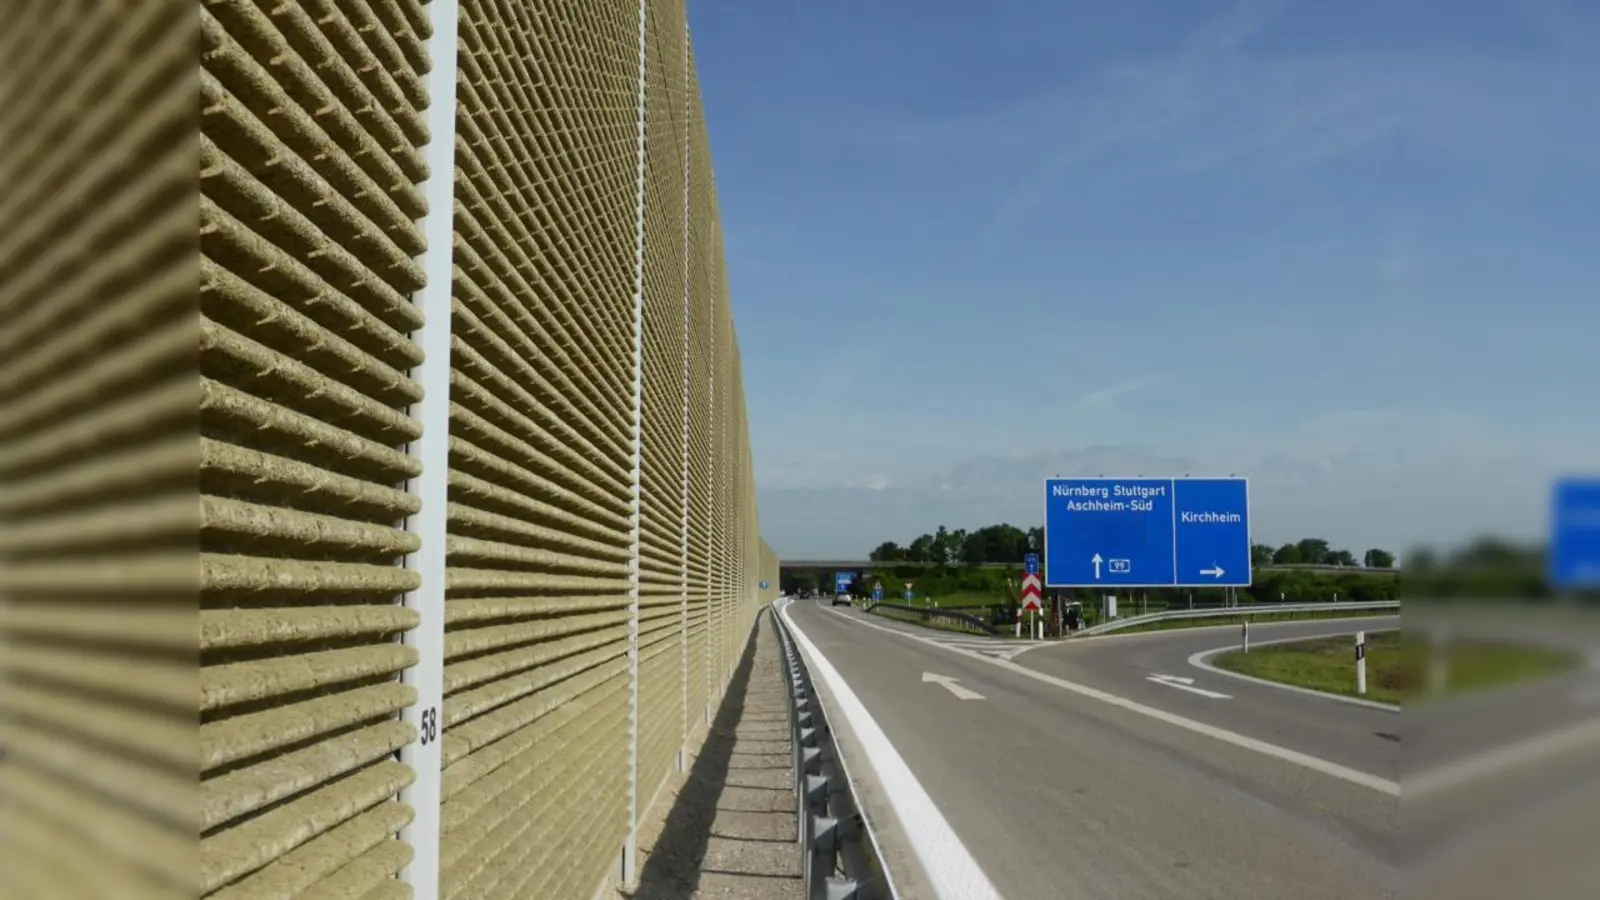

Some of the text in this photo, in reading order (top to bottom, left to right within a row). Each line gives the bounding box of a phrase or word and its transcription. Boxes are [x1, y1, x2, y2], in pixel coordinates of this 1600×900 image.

[1053, 485, 1166, 498] Nürnberg Stuttgart
[1067, 499, 1153, 511] Aschheim-Süd
[1181, 511, 1241, 523] Kirchheim
[1114, 561, 1125, 571] 99
[420, 706, 436, 746] 58
